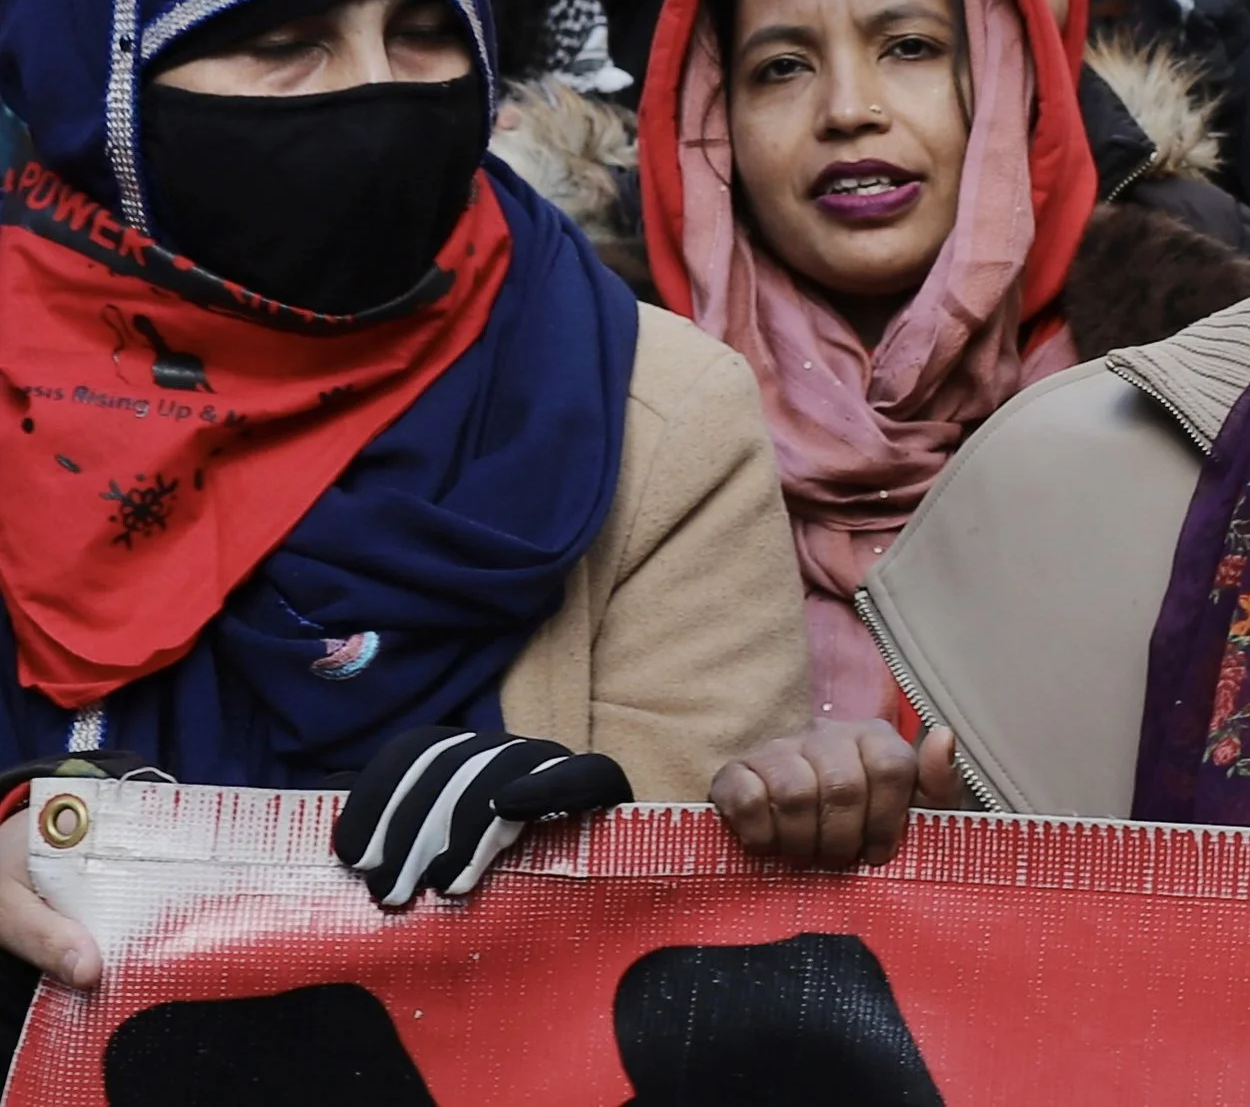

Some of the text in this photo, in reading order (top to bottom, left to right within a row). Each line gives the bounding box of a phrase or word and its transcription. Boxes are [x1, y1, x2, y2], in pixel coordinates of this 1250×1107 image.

[17, 161, 155, 267] POWER
[73, 385, 150, 420] Rising
[157, 398, 192, 422] Up
[200, 405, 218, 423] &
